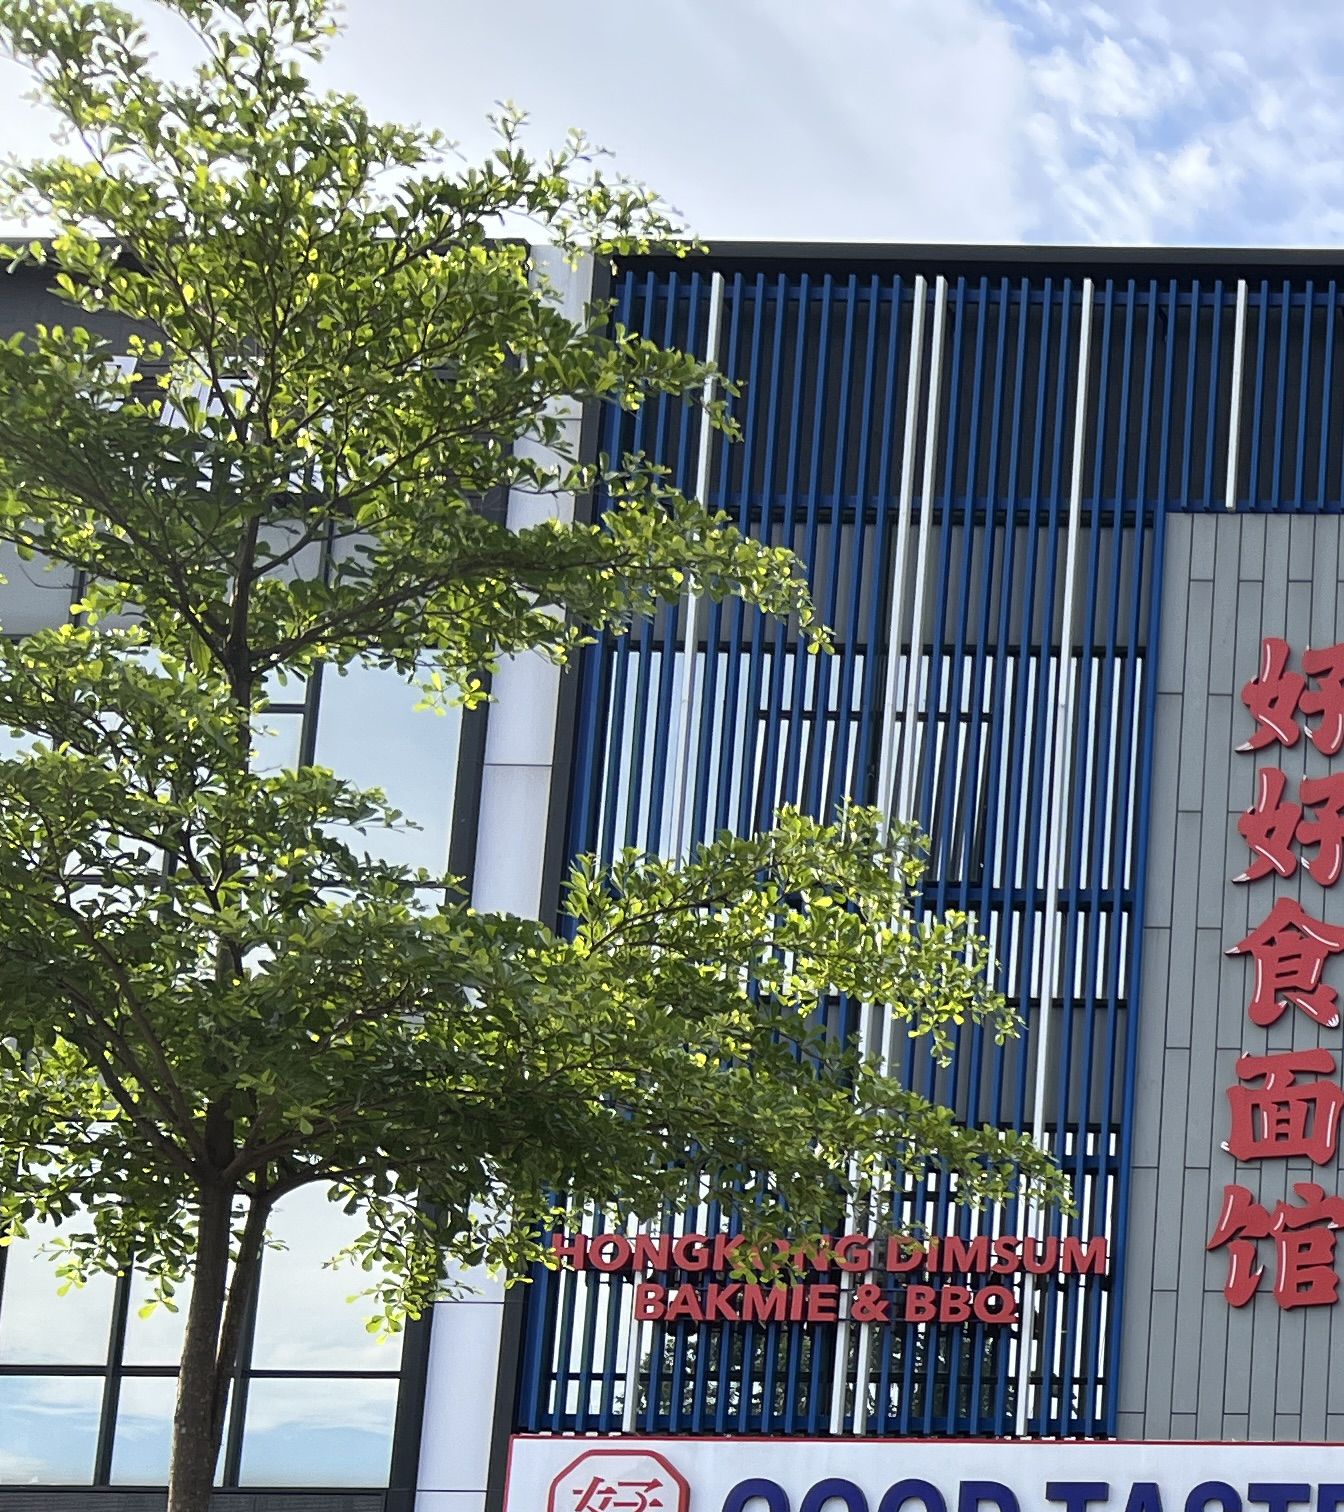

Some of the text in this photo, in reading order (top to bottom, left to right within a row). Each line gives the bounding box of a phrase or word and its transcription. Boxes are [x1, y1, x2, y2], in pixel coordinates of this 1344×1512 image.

[886, 1235, 1108, 1274] DIMSUM
[634, 1283, 1019, 1323] BAKMIE & BBQ
